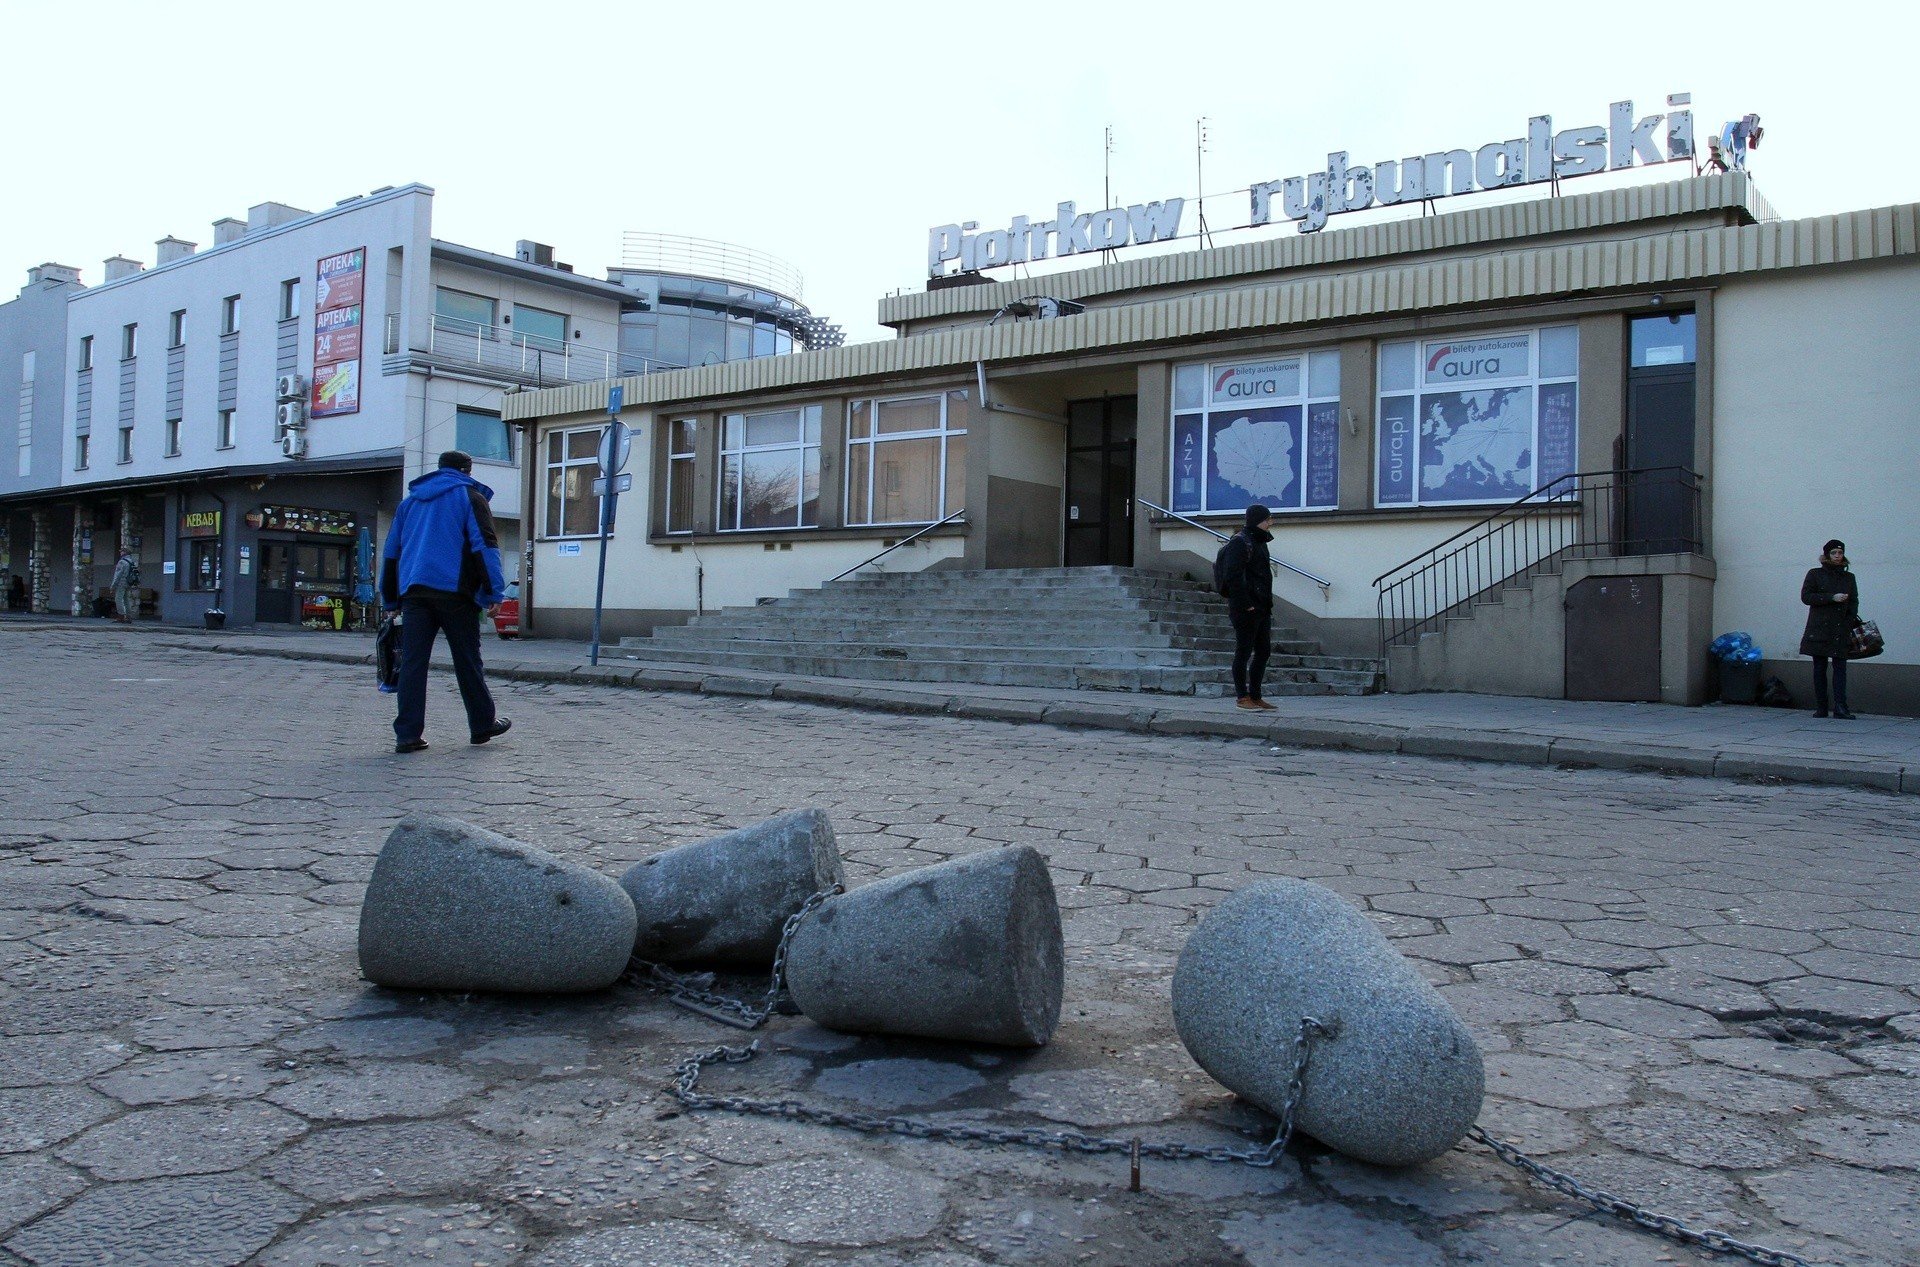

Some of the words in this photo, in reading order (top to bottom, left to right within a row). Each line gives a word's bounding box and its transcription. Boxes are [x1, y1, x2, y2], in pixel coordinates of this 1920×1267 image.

[929, 197, 1186, 279] Piotrkow
[1249, 92, 1697, 233] rybunalski
[319, 252, 354, 275] APTEKA
[317, 306, 352, 329] APTEKA
[1453, 344, 1476, 354] bilety
[1477, 339, 1529, 350] autokarowe
[1235, 366, 1256, 375] bilety
[1257, 363, 1300, 374] autokarowe
[1443, 358, 1500, 377] aura
[1228, 379, 1276, 397] aura
[1386, 417, 1410, 483] aura.pl
